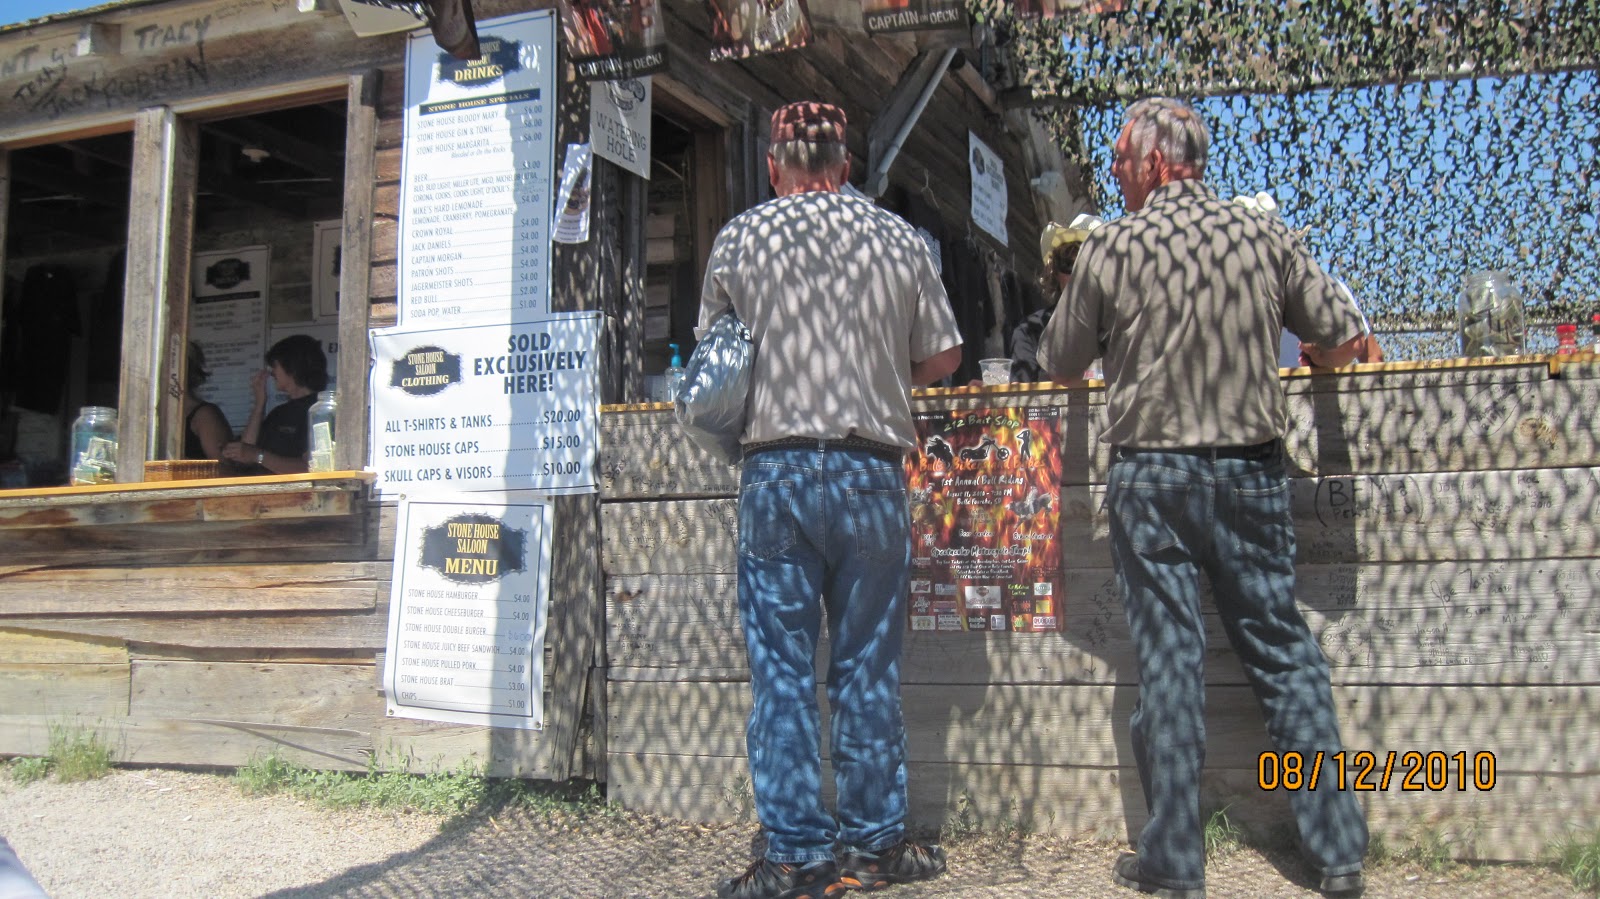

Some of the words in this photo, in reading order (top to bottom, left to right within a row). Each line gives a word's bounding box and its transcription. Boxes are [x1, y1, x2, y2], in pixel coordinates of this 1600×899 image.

[868, 10, 919, 30] CAPTAIN
[929, 8, 960, 24] DECK!
[579, 58, 623, 77] CAPTAIN
[633, 53, 662, 70] DECK!
[454, 65, 503, 81] DRINKS
[428, 103, 456, 113] STONE
[458, 99, 487, 109] HOUSE
[489, 93, 529, 105] SPECIALS
[417, 120, 434, 130] STONE
[436, 117, 455, 126] HOUSE
[457, 114, 480, 123] BLOODY
[482, 111, 499, 120] MARY
[417, 133, 434, 142] STONE
[436, 129, 455, 139] HOUSE
[457, 127, 468, 136] GIN
[476, 124, 493, 134] TONIC
[596, 111, 647, 150] WATERING
[416, 146, 434, 155] STONE
[435, 142, 455, 152] HOUSE
[457, 139, 490, 149] MARGARITA
[607, 137, 636, 164] HOLE
[414, 173, 428, 182] BEER
[413, 205, 433, 215] MIKE'S
[434, 202, 450, 212] HARD
[452, 200, 483, 210] LEMONADE
[412, 227, 433, 238] CROWN
[435, 226, 453, 236] ROYAL
[412, 242, 425, 251] JACK
[427, 240, 451, 249] DANIELS
[411, 254, 435, 264] CAPTAIN
[437, 252, 462, 262] MORGAN
[435, 266, 454, 276] SHOTS
[454, 278, 473, 288] SHOTS
[411, 296, 422, 304] RED
[424, 294, 437, 304] BULL
[411, 309, 426, 318] SODA
[442, 306, 461, 315] WATER
[508, 332, 550, 353] SOLD
[408, 352, 425, 365] STONE
[425, 351, 444, 364] HOUSE
[474, 350, 587, 376] EXCLUSIVELY
[415, 363, 436, 376] SALOON
[401, 375, 449, 387] CLOTHING
[503, 372, 553, 394] HERE!
[385, 419, 400, 433] ALL
[404, 417, 446, 431] T-SHIRTS
[449, 416, 457, 429] &
[461, 414, 492, 428] TANKS
[544, 410, 581, 424] $20.00
[944, 419, 965, 432] 212
[968, 415, 991, 426] Bait
[995, 415, 1020, 428] Shop
[385, 444, 415, 458] STONE
[418, 442, 451, 456] HOUSE
[454, 441, 479, 454] CAPS
[542, 435, 580, 450] $15.00
[384, 469, 413, 482] SKULL
[416, 467, 441, 481] CAPS
[445, 467, 452, 480] &
[456, 465, 492, 480] VISORS
[543, 461, 581, 475] $10.00
[941, 477, 953, 486] 1st
[981, 475, 997, 485] Bull
[448, 523, 473, 539] STONE
[473, 524, 499, 540] HOUSE
[456, 538, 488, 554] SALOON
[445, 557, 498, 576] MENU
[408, 588, 425, 598] STONE
[426, 589, 444, 599] HOUSE
[445, 590, 479, 600] HAMBURGER
[407, 606, 423, 615] STONE
[425, 607, 443, 616] HOUSE
[443, 608, 484, 618] CHEESEBURGER
[405, 623, 422, 632] STONE
[423, 624, 442, 633] HOUSE
[443, 625, 464, 634] DOUBLE
[465, 626, 487, 635] BURGER
[404, 640, 421, 649] STONE
[422, 641, 440, 651] HOUSE
[441, 642, 456, 652] JUICY
[457, 643, 471, 653] BEEF
[472, 644, 500, 654] SANDWICH
[402, 657, 420, 666] STONE
[421, 658, 439, 668] HOUSE
[440, 659, 461, 670] PULLED
[462, 660, 477, 671] PORK
[401, 674, 416, 684] STONE
[418, 675, 438, 685] HOUSE
[440, 677, 454, 686] BRAT
[401, 691, 417, 701] CHIPS
